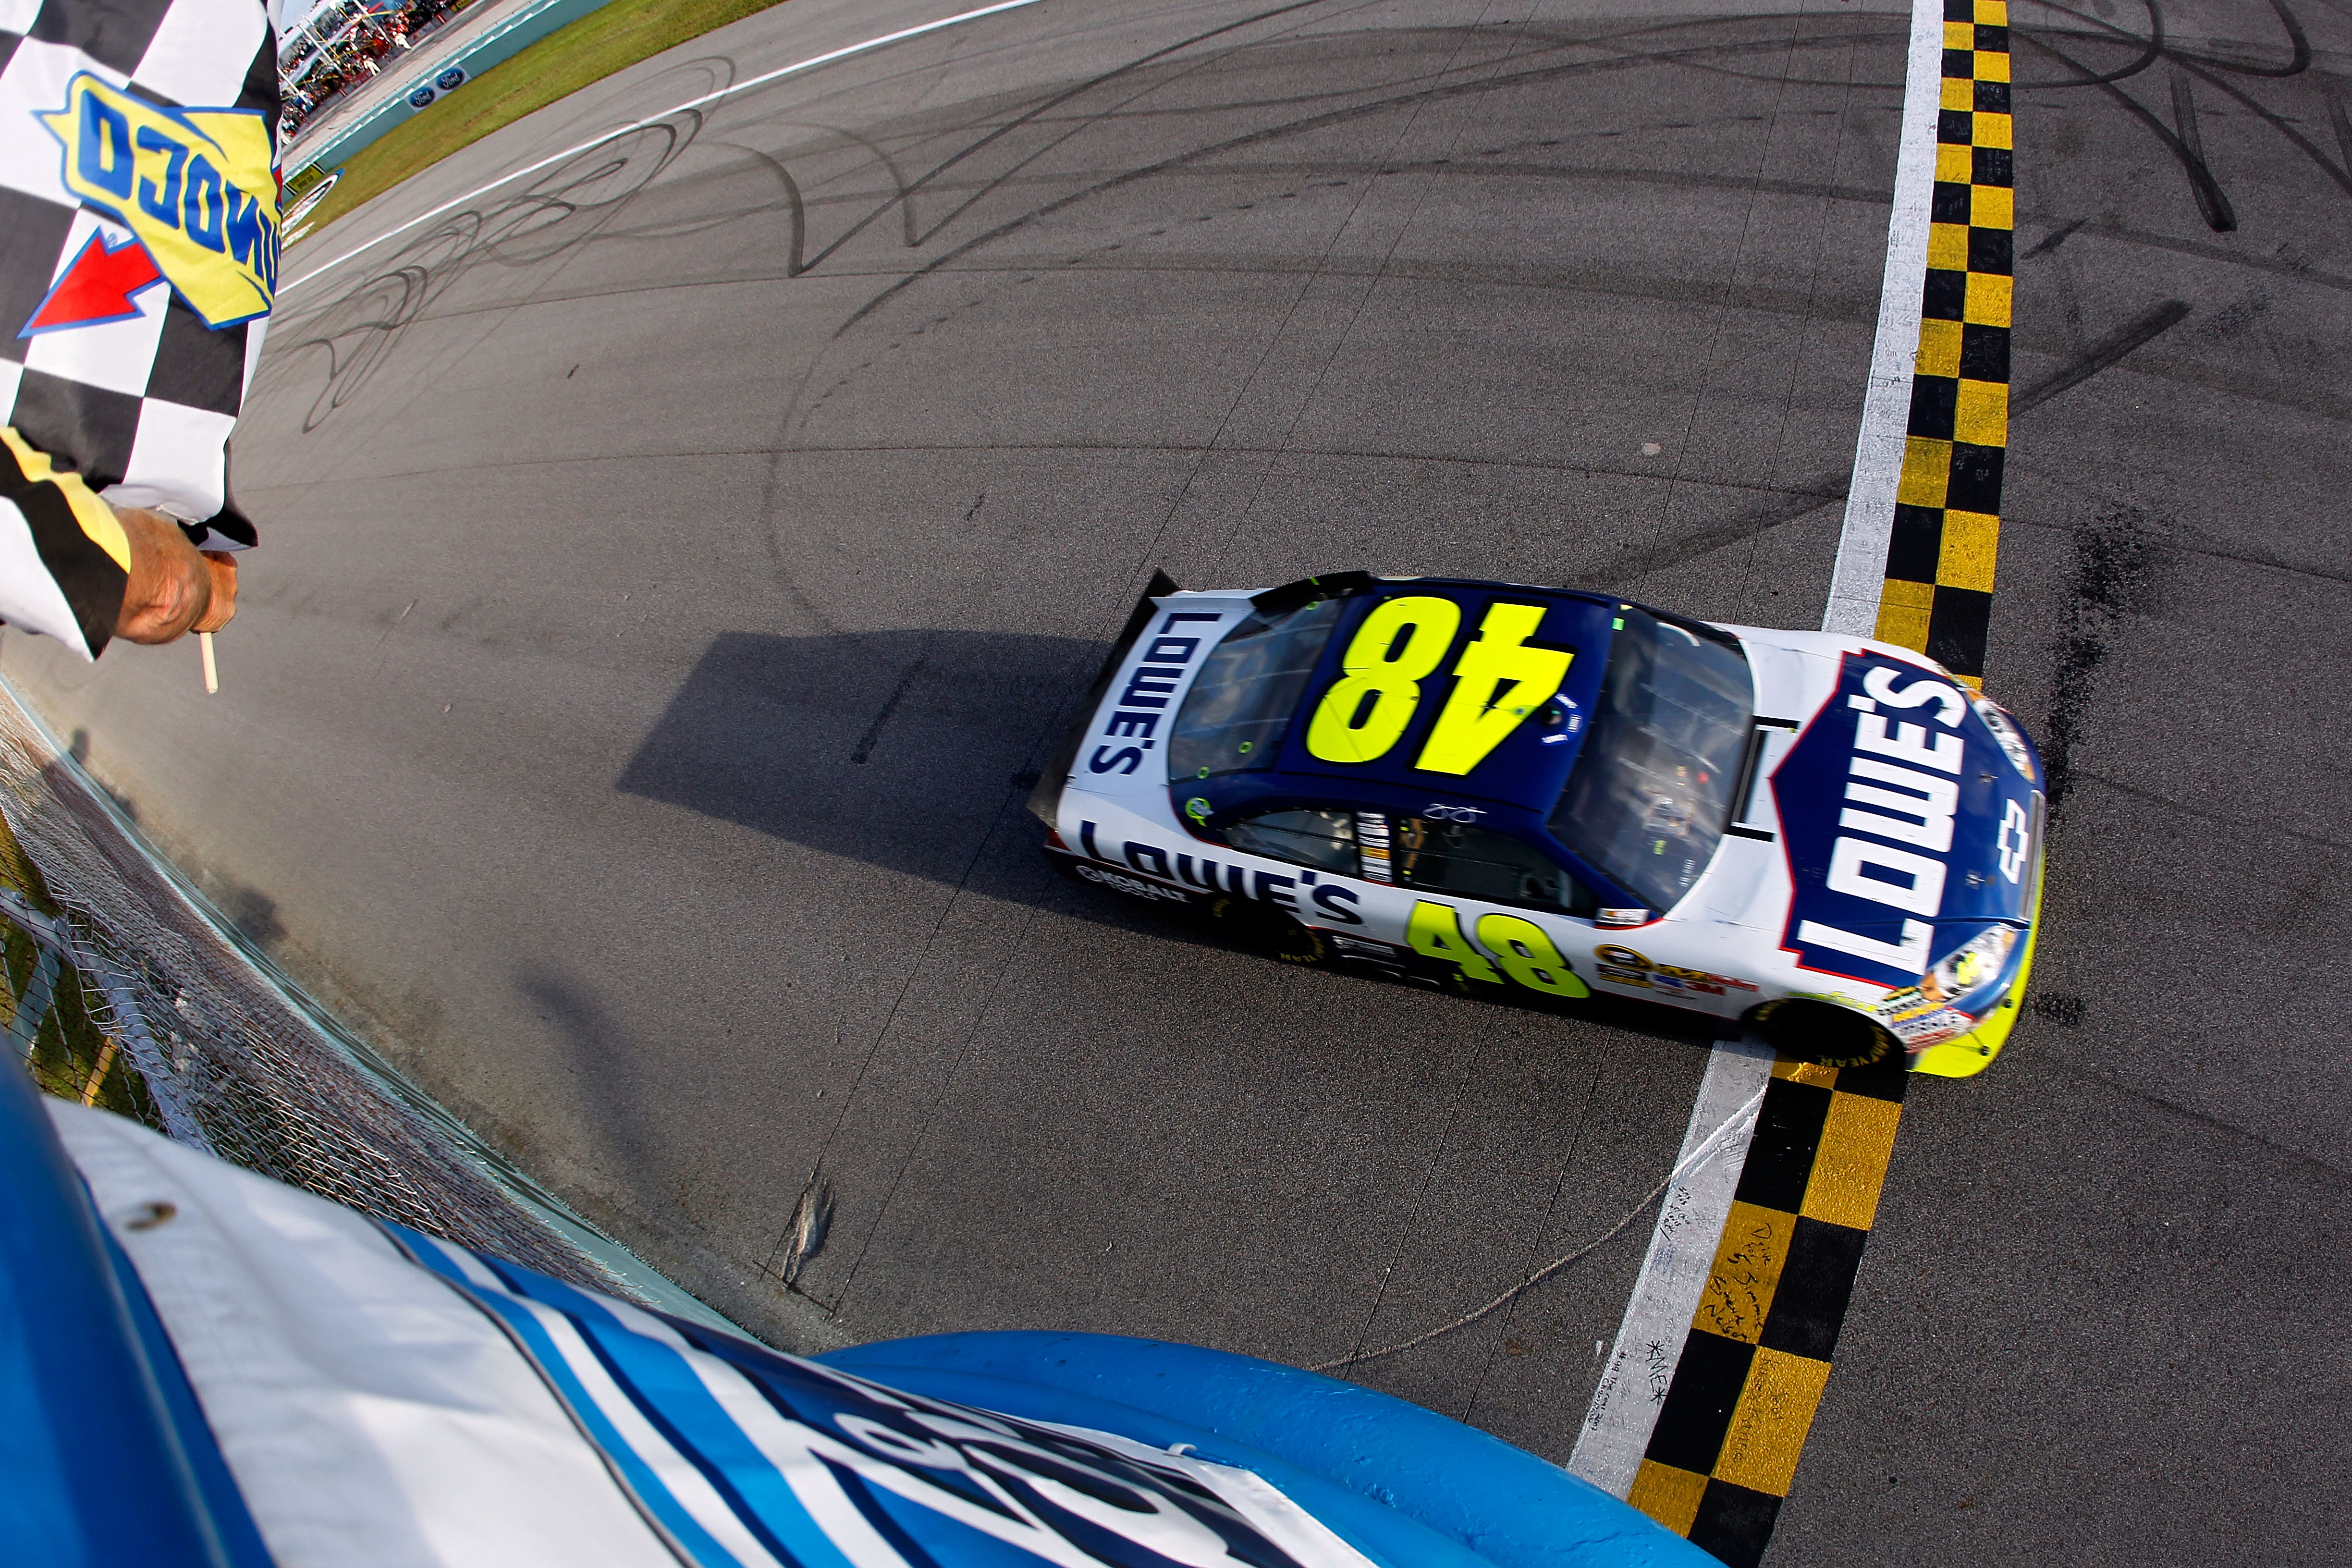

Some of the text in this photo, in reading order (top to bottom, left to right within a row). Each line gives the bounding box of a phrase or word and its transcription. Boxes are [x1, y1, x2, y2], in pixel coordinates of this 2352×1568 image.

[413, 90, 432, 106] Ford
[441, 72, 461, 88] Ford
[1089, 612, 1223, 775] LOWE'S
[1307, 596, 1574, 775] 48
[1797, 665, 1966, 976] LOWE'S
[1080, 819, 1365, 925] LOWE'S
[1102, 869, 1192, 903] KOBALT
[1111, 883, 1158, 901] TOOLS
[1406, 899, 1591, 998] 48
[1685, 980, 1726, 996] 3M
